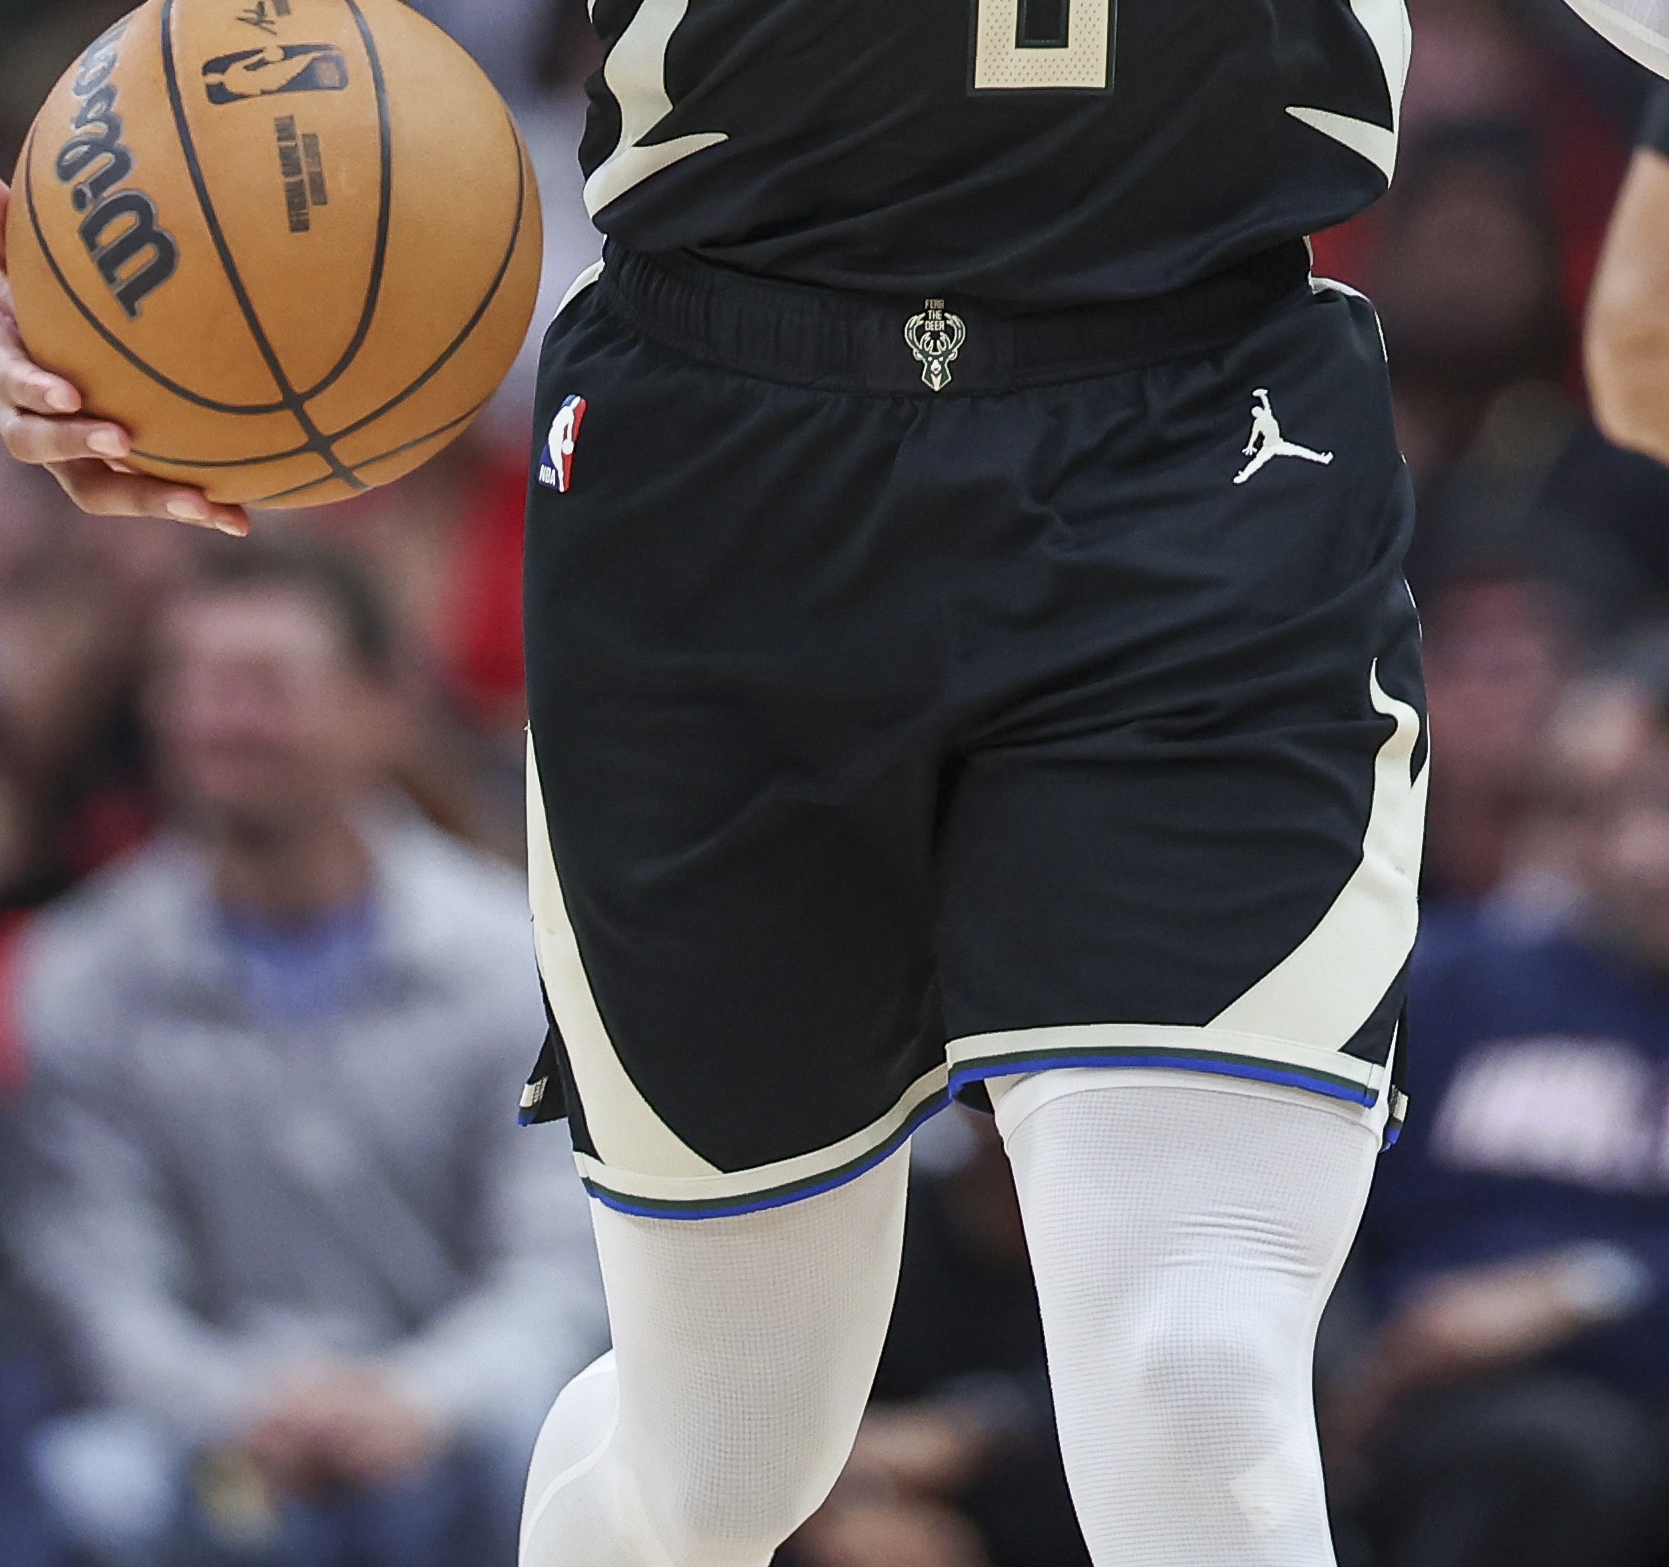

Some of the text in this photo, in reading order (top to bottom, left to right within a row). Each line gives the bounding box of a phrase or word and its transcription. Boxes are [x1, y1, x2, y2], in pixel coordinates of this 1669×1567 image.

[928, 310, 942, 320] THE
[925, 321, 944, 330] DEER
[539, 464, 556, 486] NBA
